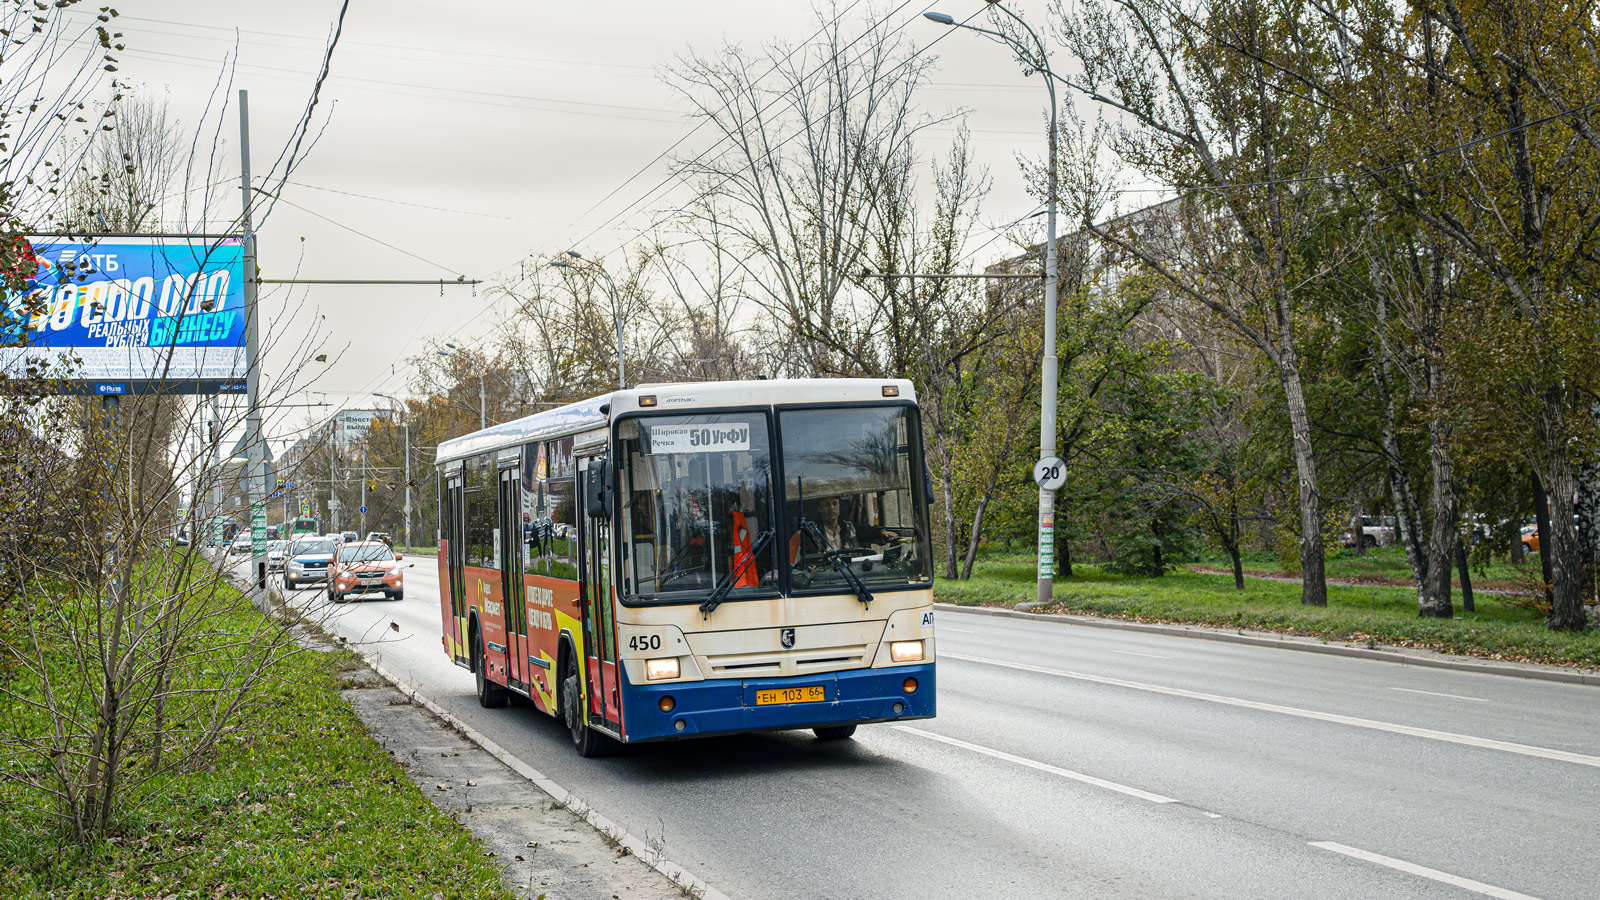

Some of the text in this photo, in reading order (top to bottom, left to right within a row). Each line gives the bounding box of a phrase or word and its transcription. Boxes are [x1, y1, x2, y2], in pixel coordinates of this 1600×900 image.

[79, 254, 119, 272] ВТБ
[37, 283, 78, 332] 10
[88, 319, 150, 339] РЕАЛЬНЫХ
[149, 310, 236, 346] БИЗНЕСУ
[652, 428, 688, 437] Широкая
[689, 428, 748, 447] 50 УрФУ
[652, 439, 675, 447] Речка
[1041, 466, 1060, 480] 20
[629, 634, 662, 651] 450
[762, 687, 820, 703] ЕН 103 66
